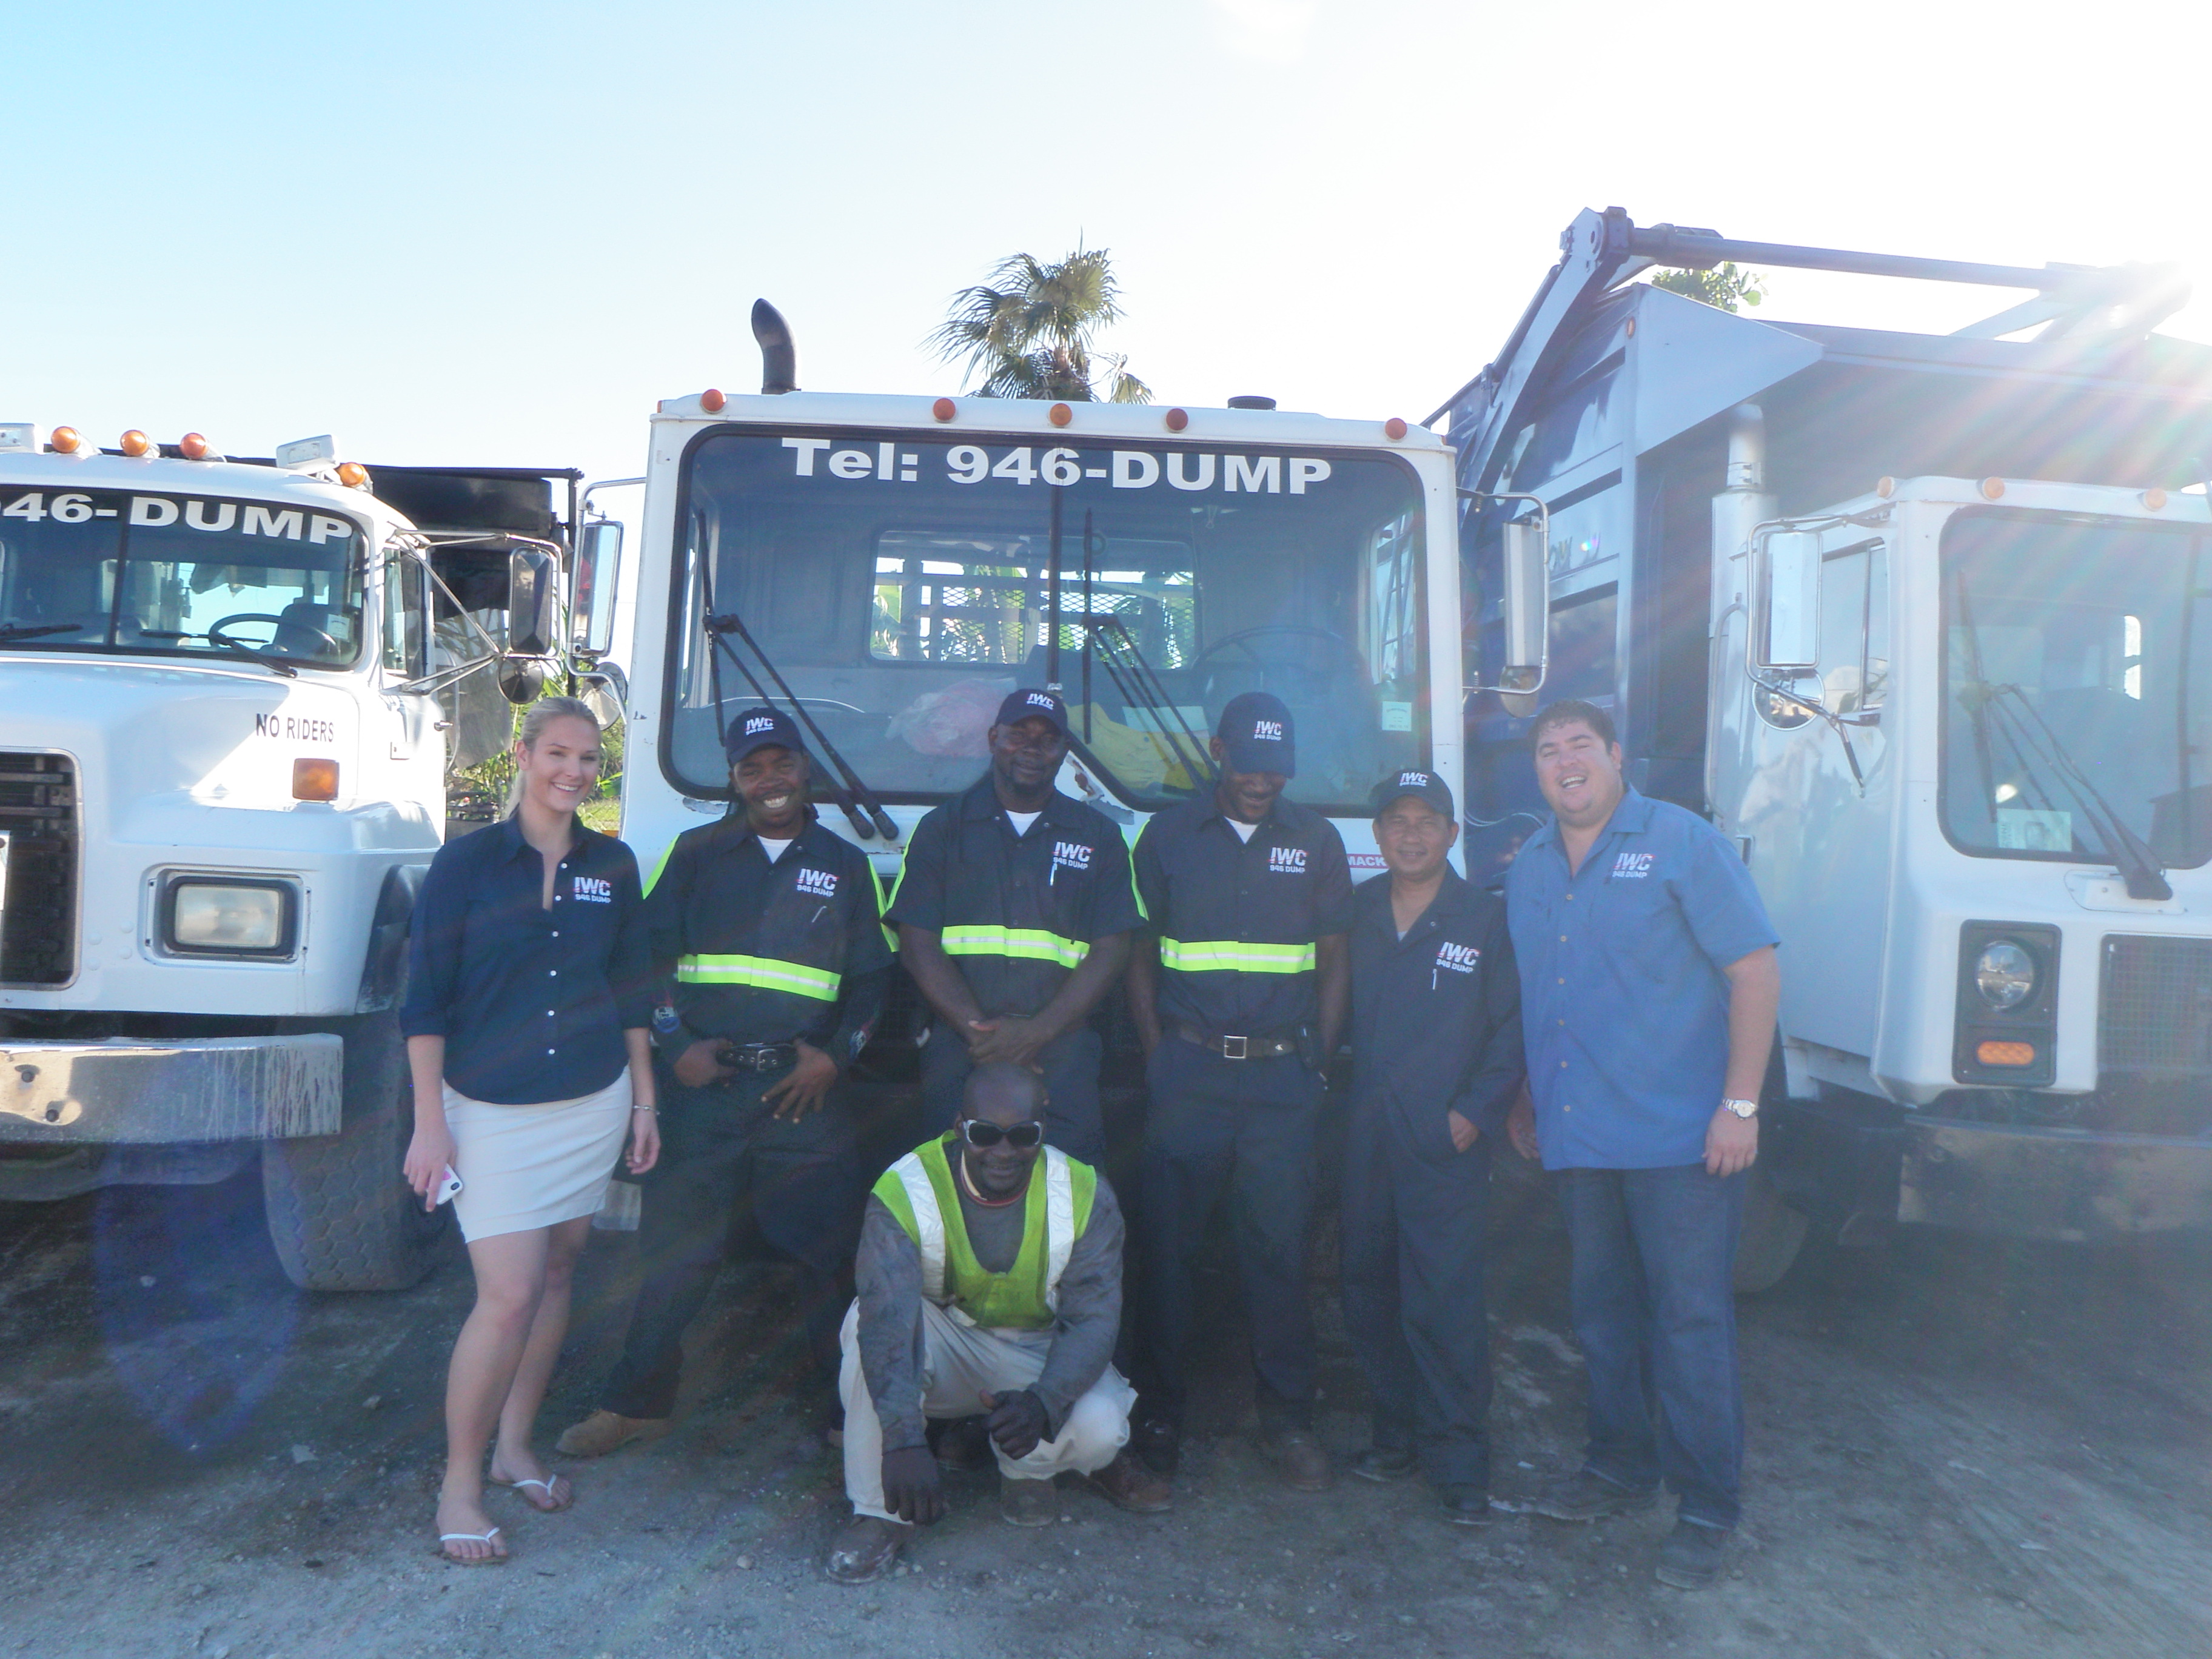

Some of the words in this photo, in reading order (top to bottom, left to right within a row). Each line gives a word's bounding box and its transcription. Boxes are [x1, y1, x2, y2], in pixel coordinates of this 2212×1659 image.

[781, 438, 918, 482] Tel:
[946, 444, 1332, 495] 946-DUMP
[0, 492, 353, 545] 46-DUMP
[1028, 693, 1054, 707] IWC
[256, 713, 280, 737] NO
[287, 717, 333, 742] RIDERS
[746, 717, 773, 731] IWC
[1255, 720, 1281, 736] IWC
[1400, 772, 1428, 783] IWC
[1054, 841, 1091, 862] IWC
[1270, 846, 1307, 866] IWC
[1053, 857, 1067, 865] 946
[1068, 859, 1088, 870] DUMP
[1614, 853, 1652, 871] IWC
[574, 876, 611, 897] IWC
[798, 868, 837, 890] IWC
[797, 884, 813, 893] 946
[813, 886, 834, 897] DUMP
[1438, 941, 1480, 966] IWC
[1436, 958, 1452, 968] 946
[1451, 962, 1473, 973] DUMP
